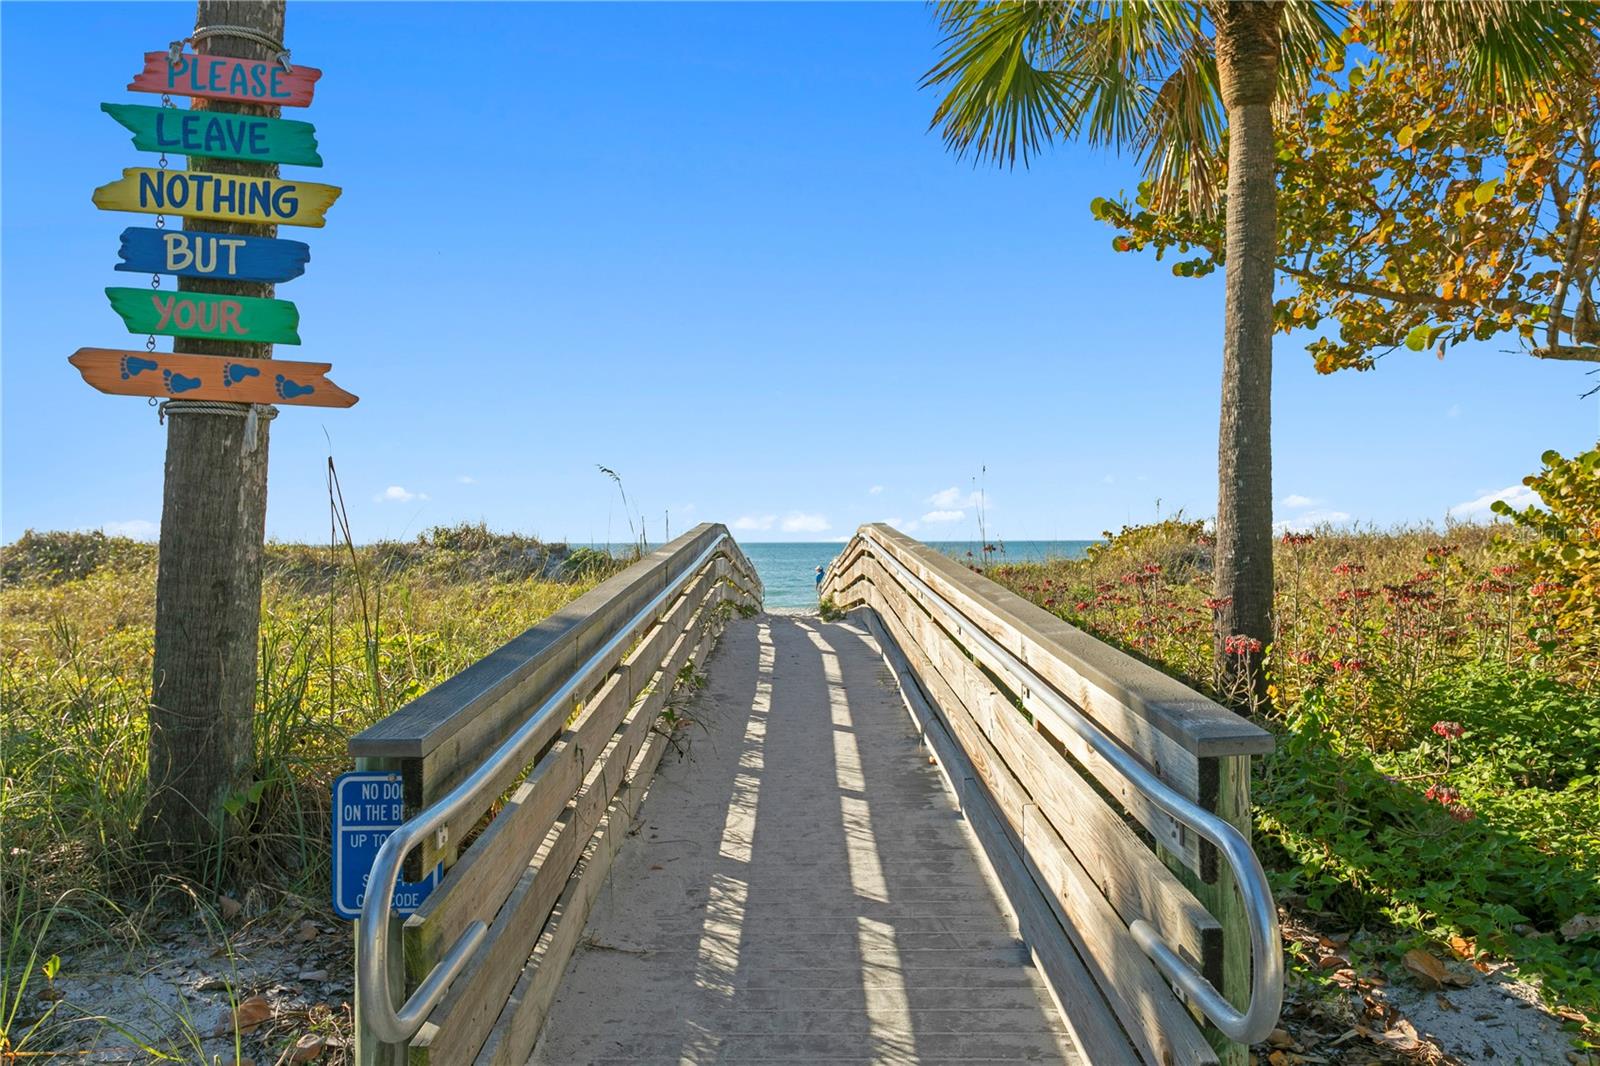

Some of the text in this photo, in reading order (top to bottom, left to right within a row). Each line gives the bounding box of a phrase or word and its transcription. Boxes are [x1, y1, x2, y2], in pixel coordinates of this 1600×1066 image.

[165, 56, 292, 98] PLEASE
[156, 112, 270, 155] LEAVE
[139, 171, 299, 219] NOTHING
[163, 232, 247, 275] BUT
[152, 295, 249, 335] YOUR
[362, 783, 379, 800] NO
[344, 804, 361, 821] ON
[365, 804, 388, 821] THE
[350, 834, 367, 848] UP
